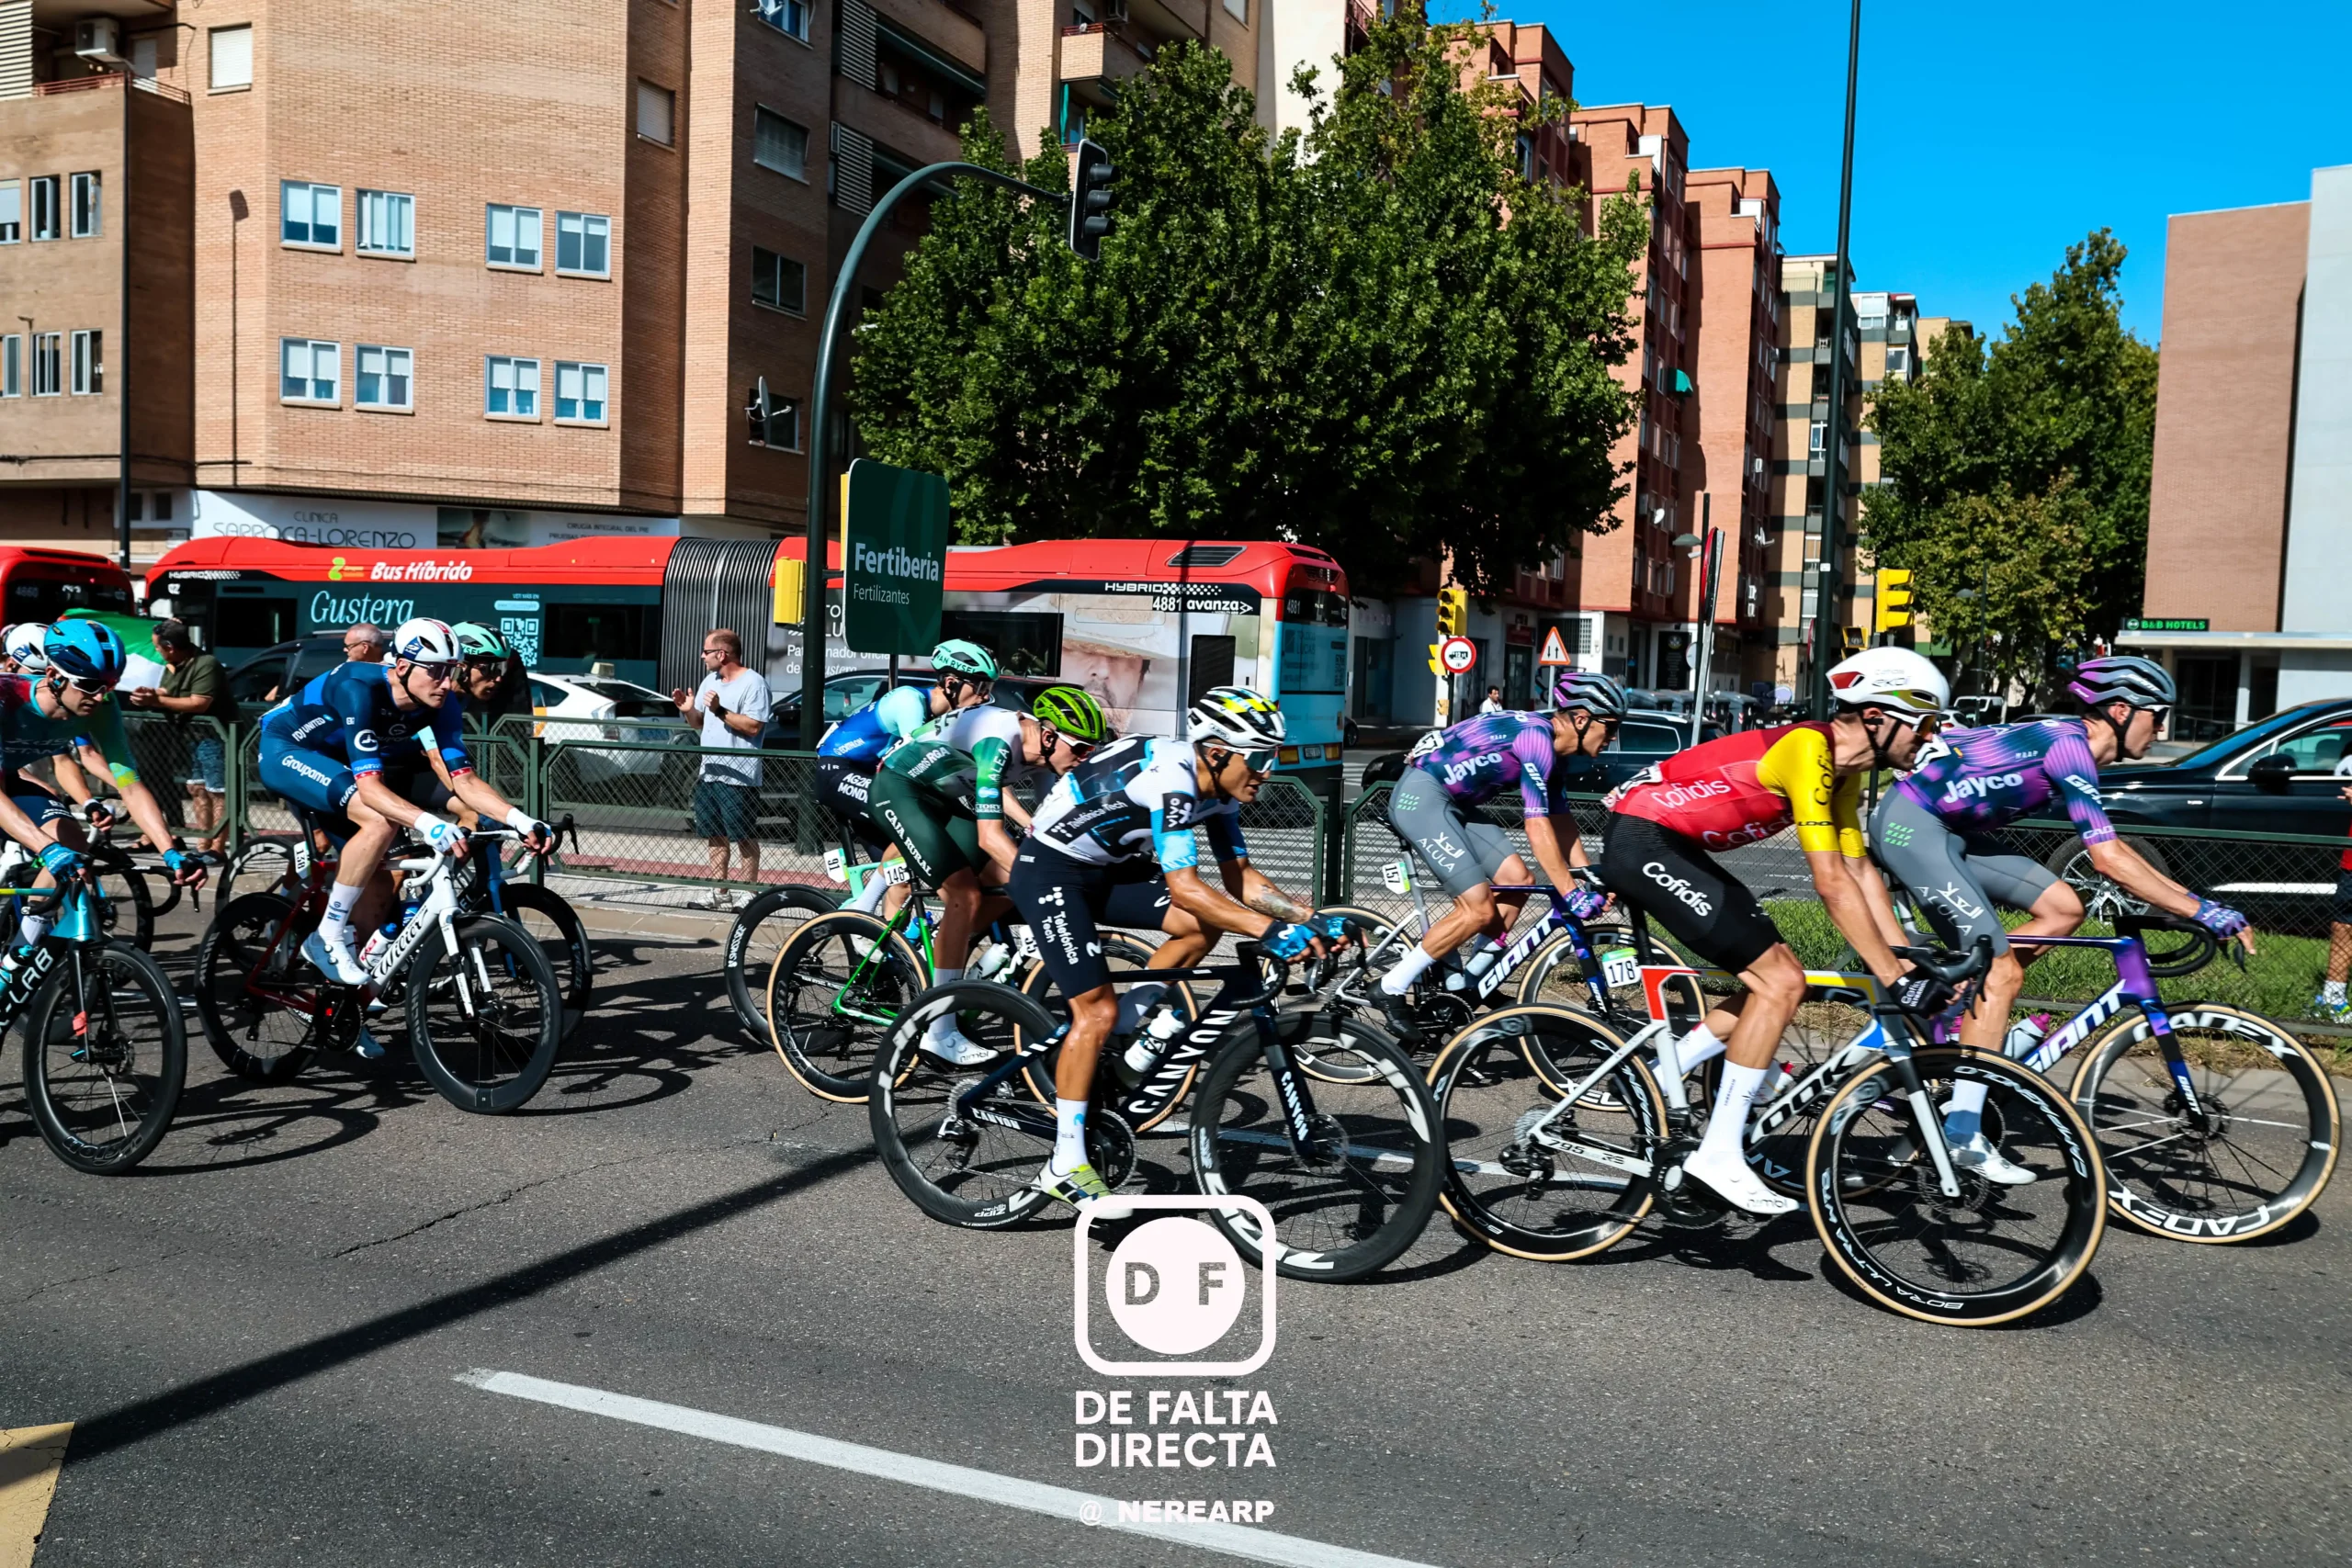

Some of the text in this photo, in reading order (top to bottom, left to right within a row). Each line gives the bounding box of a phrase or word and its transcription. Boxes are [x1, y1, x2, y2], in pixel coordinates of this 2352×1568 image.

[370, 561, 402, 581] Bus
[404, 559, 473, 581] Híbrido
[854, 542, 939, 581] Fertiberia
[854, 583, 910, 605] Fertilizantes
[1104, 581, 1163, 593] HYBRID
[311, 590, 414, 626] Gustera
[1152, 596, 1239, 612] 4881 avanza
[2141, 620, 2206, 630] B&B HOTELS
[302, 716, 326, 734] UNITED
[281, 754, 333, 787] Groupama
[927, 747, 951, 766] RGA
[988, 747, 1010, 783] ALEA
[1443, 752, 1503, 786] Jayco
[1650, 778, 1731, 810] Cofidis
[1943, 772, 2024, 804] Jayco
[1102, 800, 1128, 813] Tech
[1166, 797, 1181, 828] vivo
[885, 808, 933, 877] CAJA RURAL
[1416, 837, 1456, 874] ALULA
[827, 855, 840, 871] 91
[887, 866, 907, 884] 146
[1385, 865, 1401, 884] 157
[1642, 861, 1713, 918] Cofidis
[1913, 886, 1973, 936] ALULA
[1041, 916, 1057, 943] Tech
[1053, 911, 1080, 965] Telefónica
[198, 931, 221, 987] MICHE
[1477, 908, 1557, 1000] GIANT
[1610, 959, 1635, 984] 178
[1589, 981, 1607, 1013] GIANT
[2132, 1010, 2301, 1060] CADEX
[959, 1051, 989, 1063] nimbl
[1128, 1010, 1240, 1114] CANYON
[1281, 1071, 1309, 1141] CANYON
[2177, 1075, 2203, 1116] GIANT
[972, 1108, 1022, 1130] CANYON
[1548, 1138, 1586, 1156] 795
[1747, 1196, 1789, 1210] nimbl
[2108, 1188, 2270, 1236] CADEX
[1895, 1285, 1964, 1310] BORA
